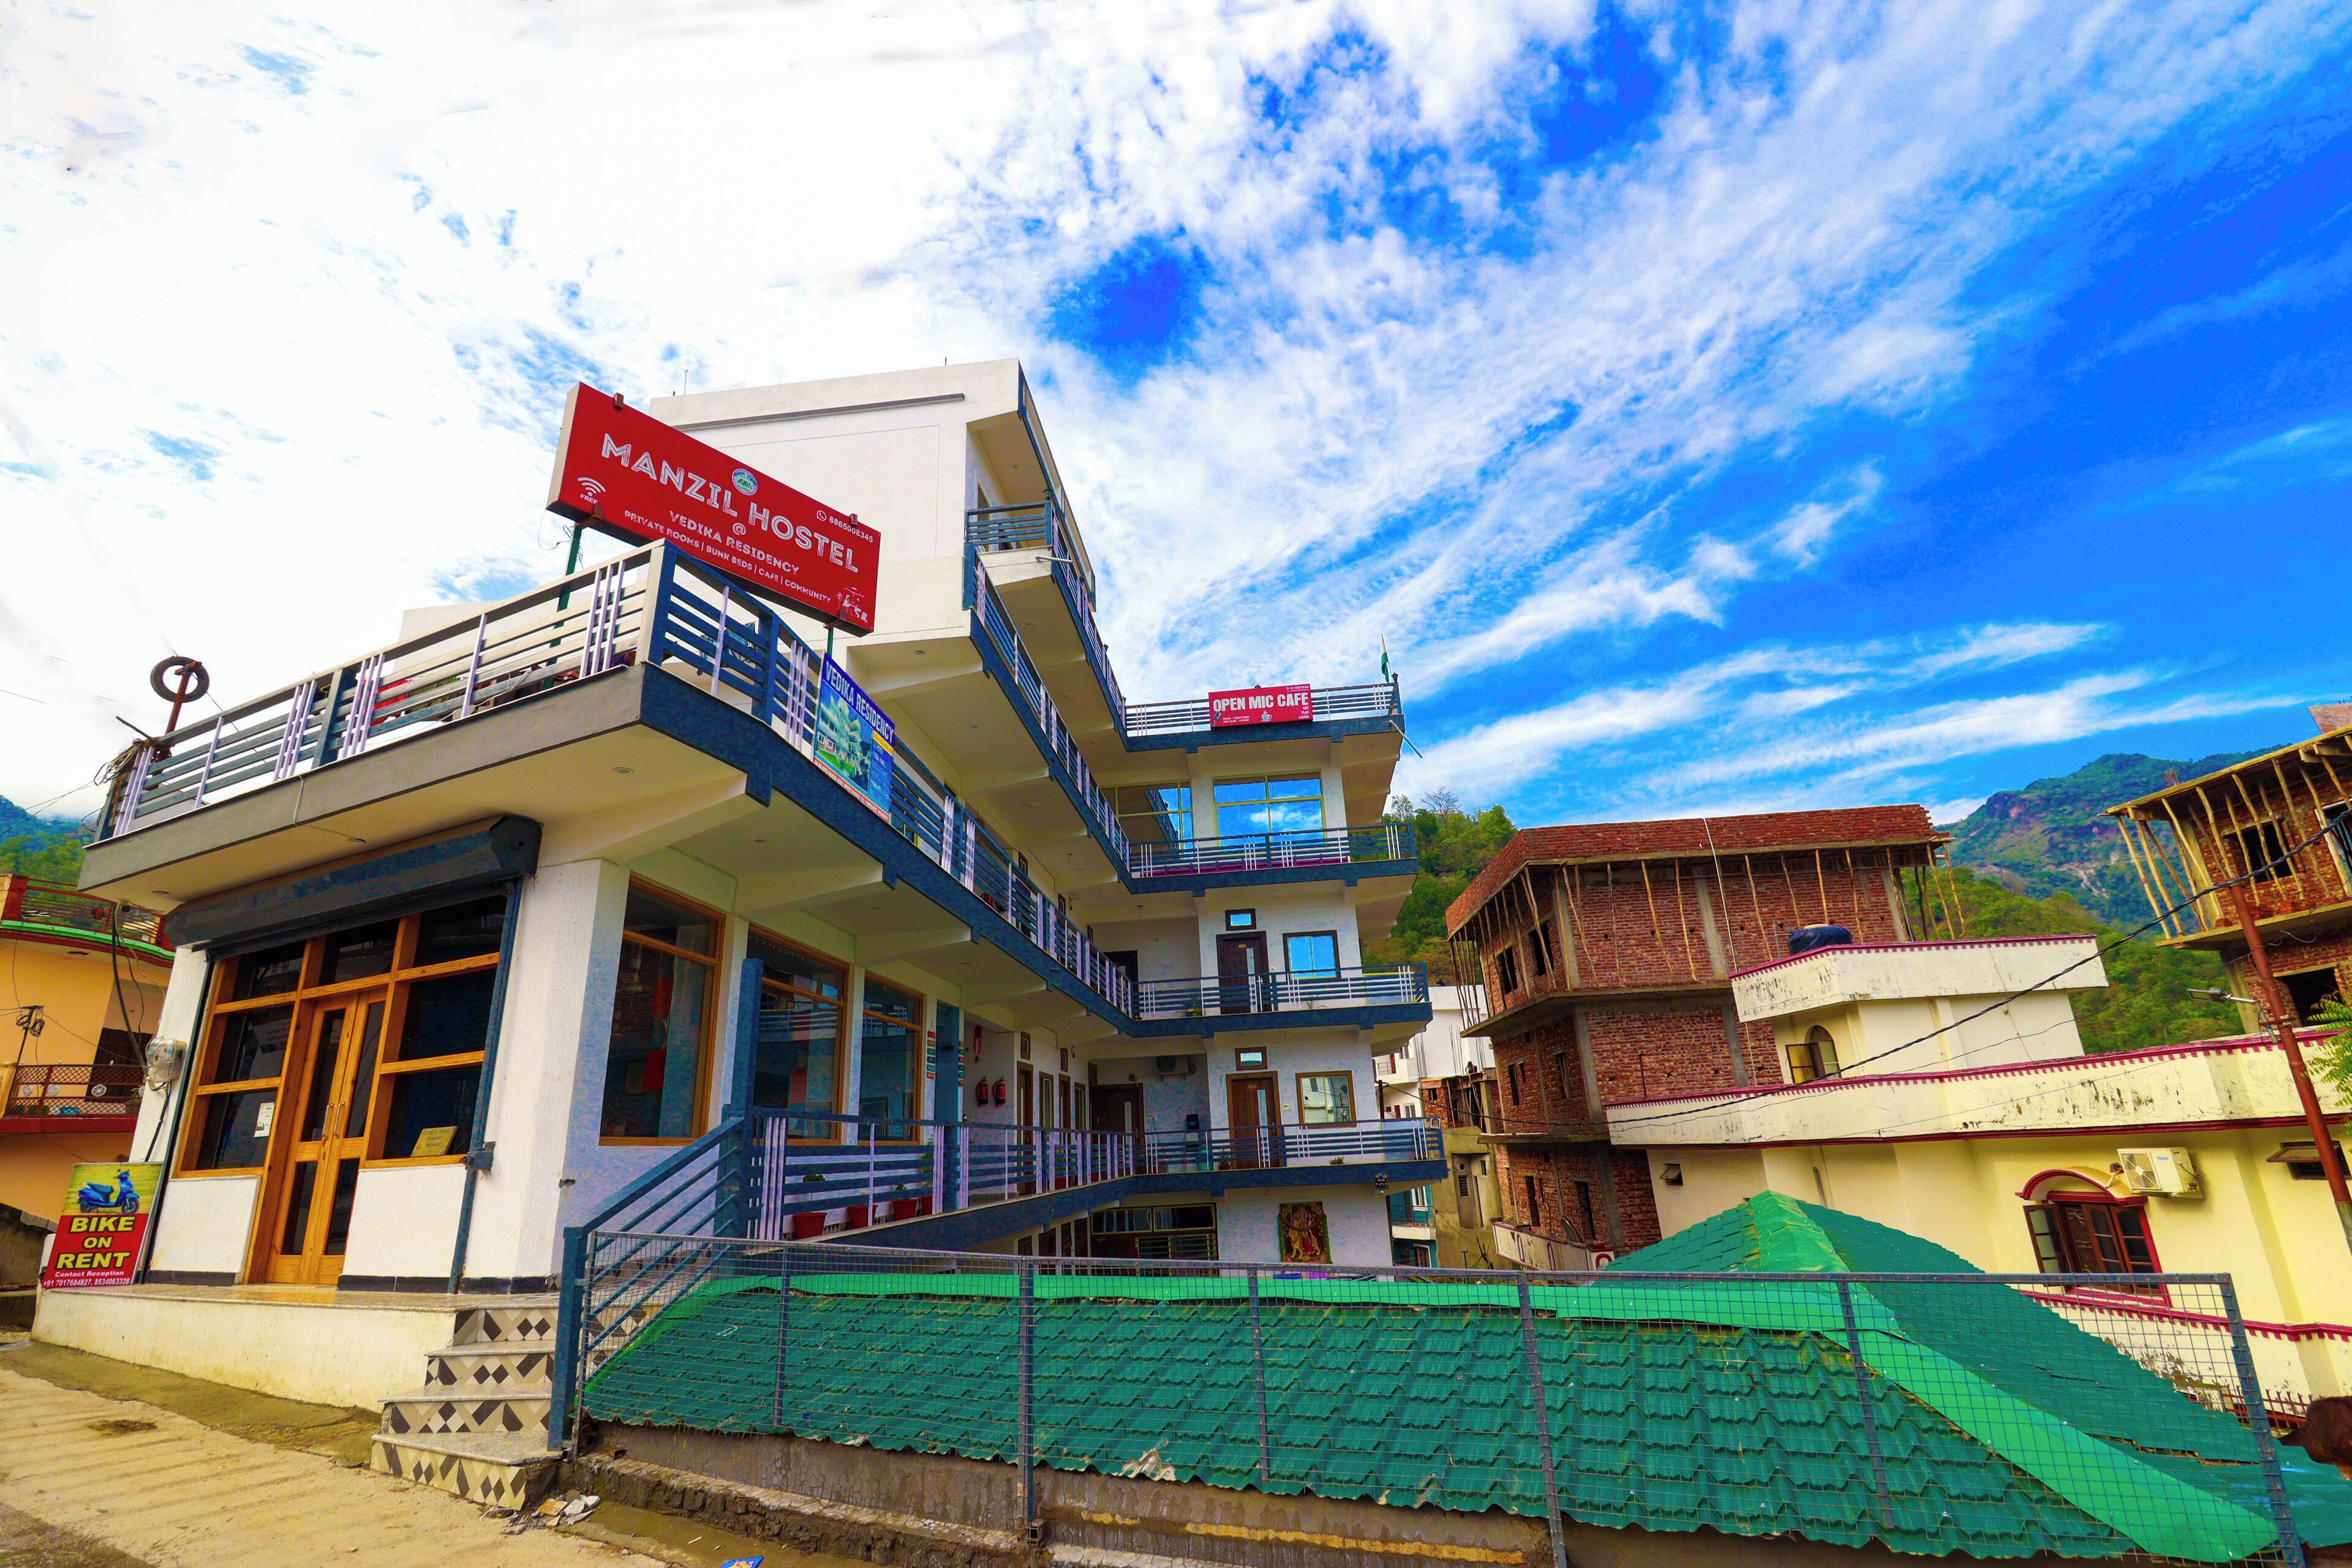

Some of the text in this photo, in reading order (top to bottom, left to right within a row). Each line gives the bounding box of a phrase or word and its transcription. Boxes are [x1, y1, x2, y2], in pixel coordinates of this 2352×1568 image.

[601, 432, 859, 573] MANZIL HOSTEL
[669, 510, 799, 575] VEDIKA RESIDENCY
[829, 516, 873, 543] 8865008345
[624, 510, 831, 603] PRIVATE ROOMS BUNK BEDS CAFE COMMUNITY
[826, 661, 854, 706] VEDIKA
[856, 693, 894, 743] RESIDENCY
[1213, 692, 1308, 712] OPEN MIC CAFE
[70, 1216, 135, 1232] BIKE
[83, 1237, 112, 1248] ON
[57, 1252, 130, 1269] RENT
